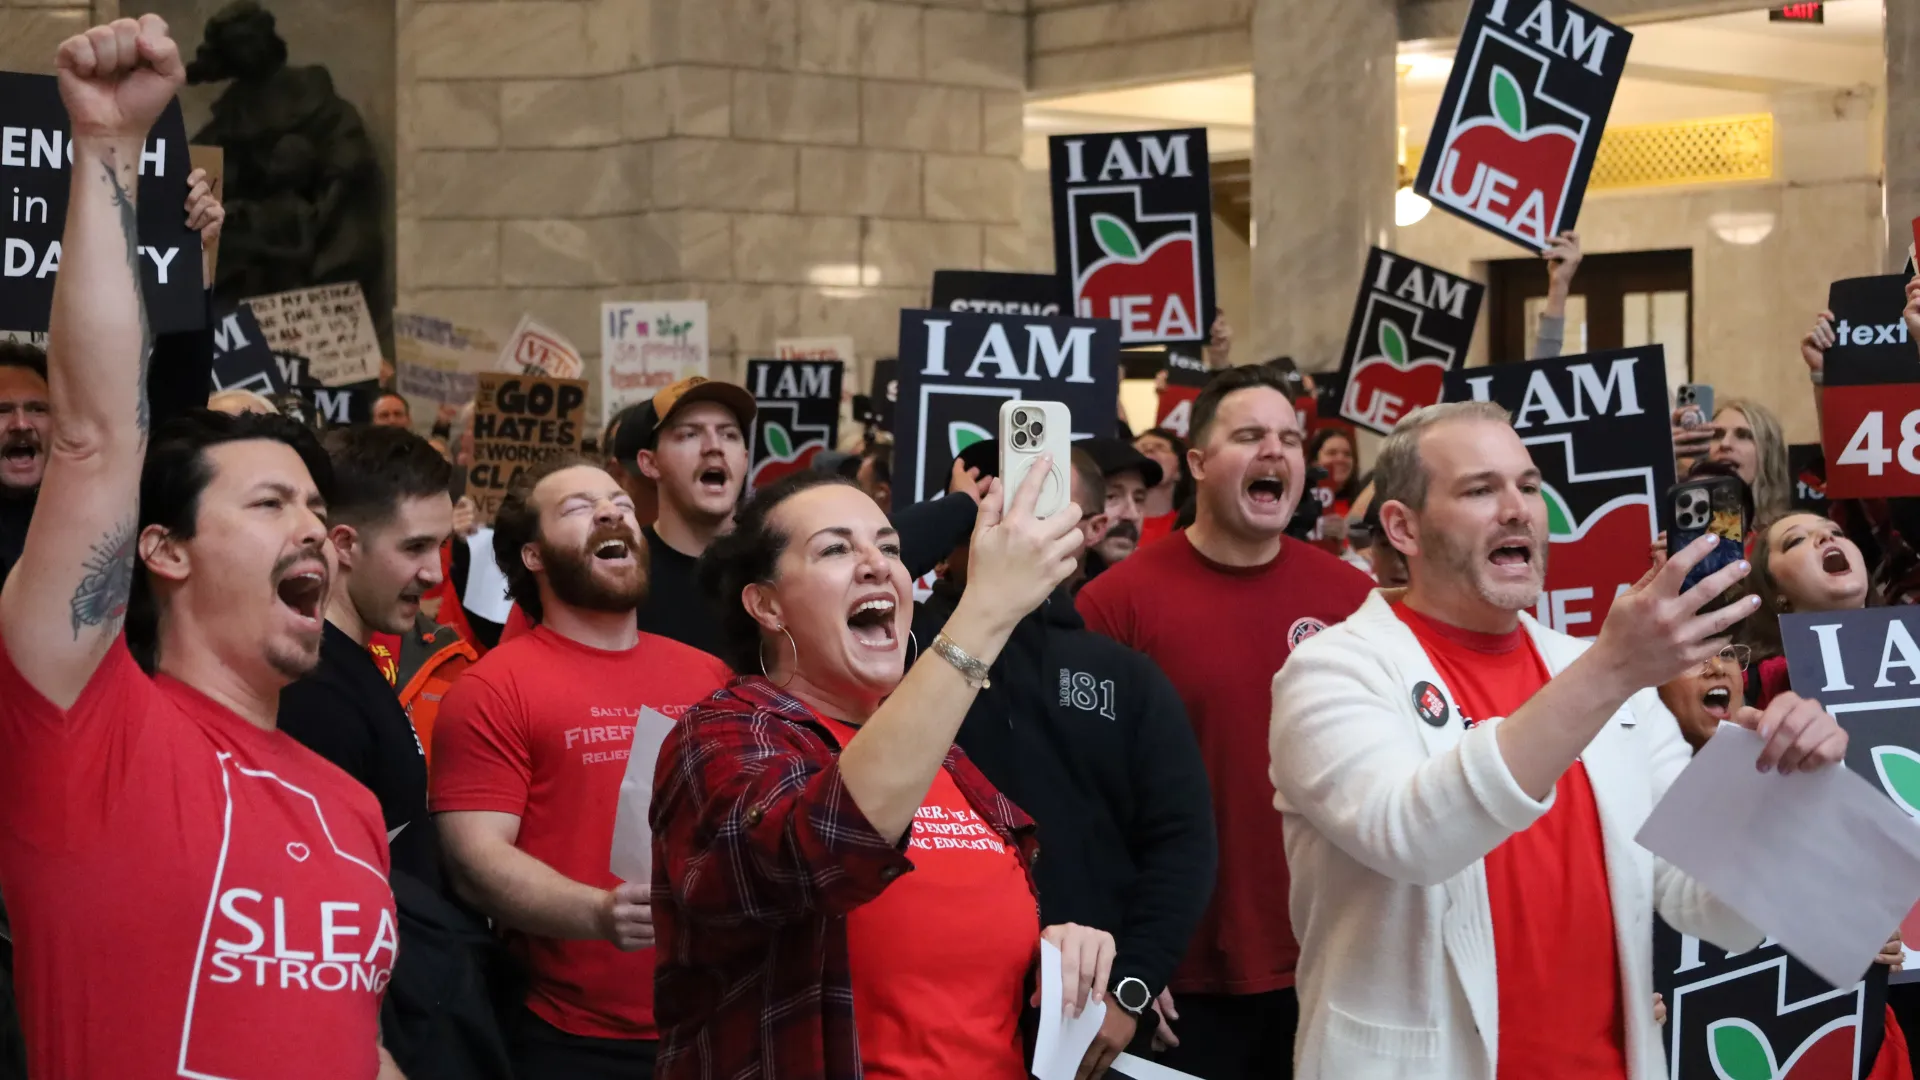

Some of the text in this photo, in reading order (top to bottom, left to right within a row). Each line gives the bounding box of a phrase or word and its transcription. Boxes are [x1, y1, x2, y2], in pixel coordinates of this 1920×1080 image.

[1515, 0, 1615, 76] AM
[1064, 134, 1192, 182] I AM
[12, 187, 48, 223] in
[1441, 148, 1549, 247] UEA
[1373, 255, 1470, 320] I AM
[920, 319, 1096, 383] I AM
[1837, 318, 1908, 346] text
[497, 380, 584, 419] GOP
[756, 363, 834, 398] I AM
[1514, 357, 1645, 429] AM
[312, 389, 352, 424] M
[474, 413, 575, 446] HATES
[1350, 380, 1425, 434] UE
[1809, 624, 1854, 692] I
[591, 707, 622, 717] SALT
[662, 704, 691, 715] CIT
[1071, 672, 1116, 721] 81
[932, 837, 1005, 855] EDUCATION
[215, 887, 398, 966] SLEA
[210, 951, 391, 994] STRONG
